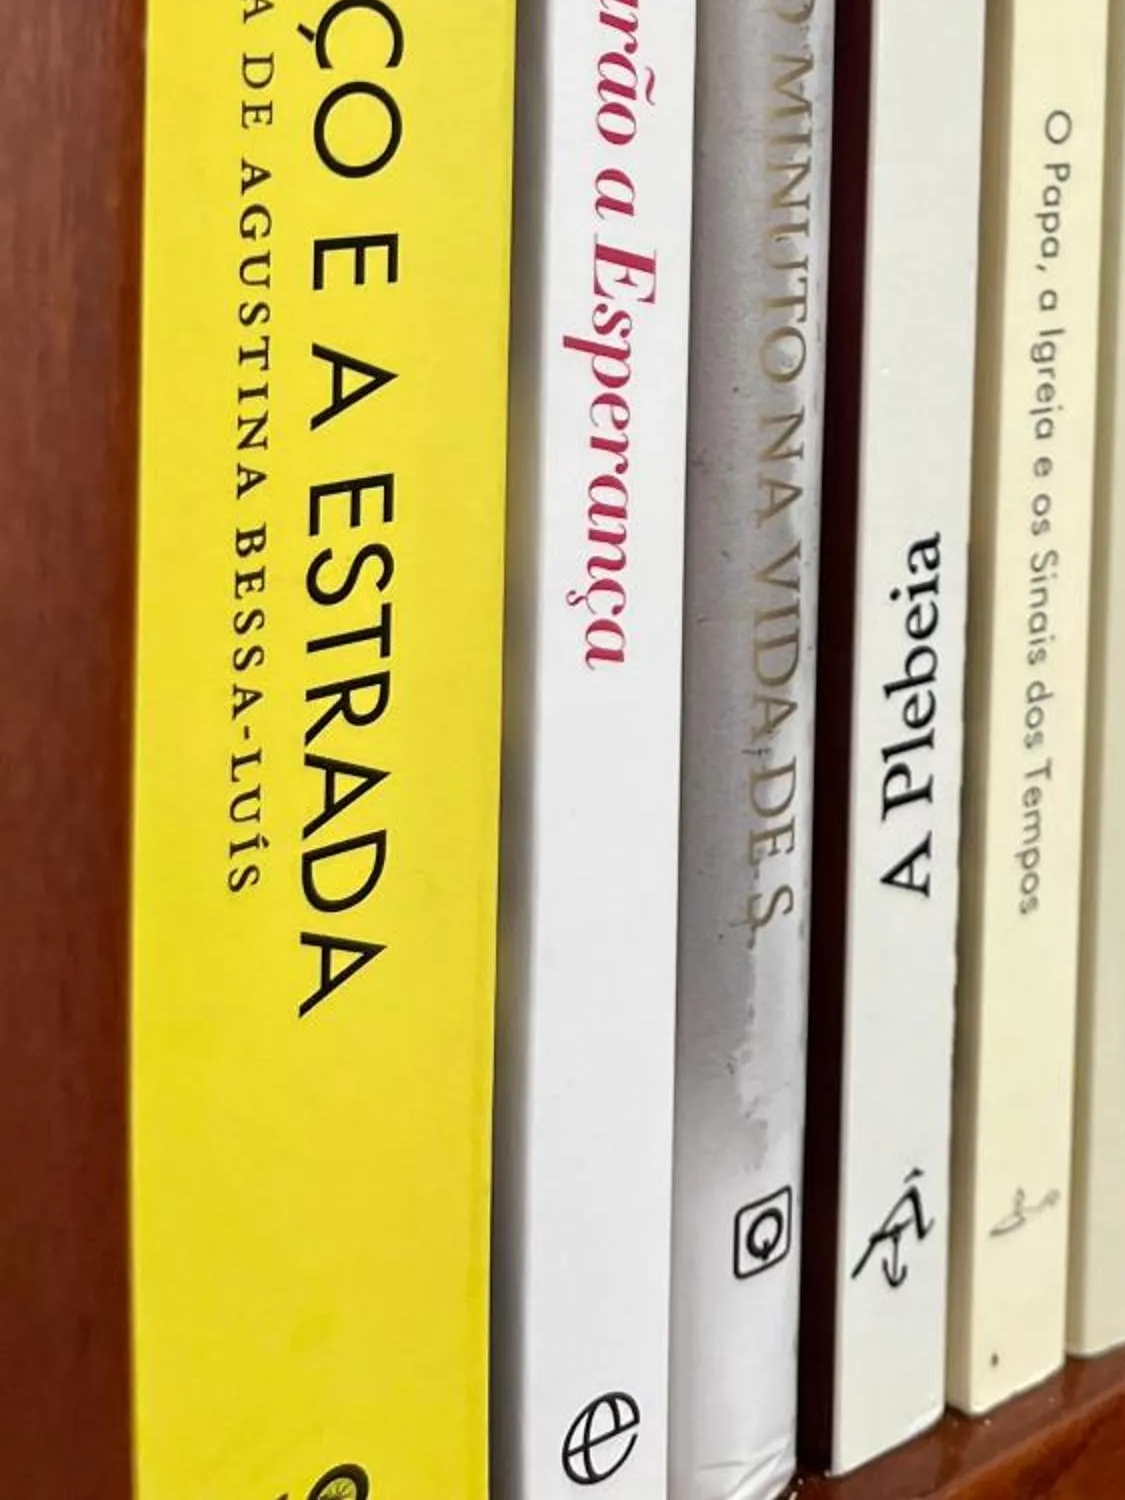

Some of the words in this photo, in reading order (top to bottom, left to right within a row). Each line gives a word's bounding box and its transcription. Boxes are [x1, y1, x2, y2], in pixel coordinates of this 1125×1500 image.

[240, 52, 274, 129] DE
[1044, 110, 1072, 144] O
[593, 166, 638, 220] a
[754, 53, 814, 385] MINUTO
[1035, 163, 1070, 272] Papa,
[311, 232, 398, 291] E
[1038, 289, 1057, 310] a
[235, 157, 273, 499] AGUSTINA
[309, 343, 400, 431] A
[1029, 327, 1066, 439] Igreja
[561, 233, 656, 670] Esperança
[753, 411, 807, 529] NA
[1033, 457, 1053, 478] e
[1030, 493, 1051, 537] os
[749, 549, 803, 738] VIDA
[1026, 549, 1059, 667] Sinais
[226, 522, 271, 894] BESSA-LUÍS
[881, 532, 941, 820] Plebeia
[1024, 680, 1053, 750] dos
[298, 473, 395, 1018] ESTRADA
[746, 757, 797, 865] DE
[880, 832, 931, 898] A
[1014, 759, 1051, 917] Tempos
